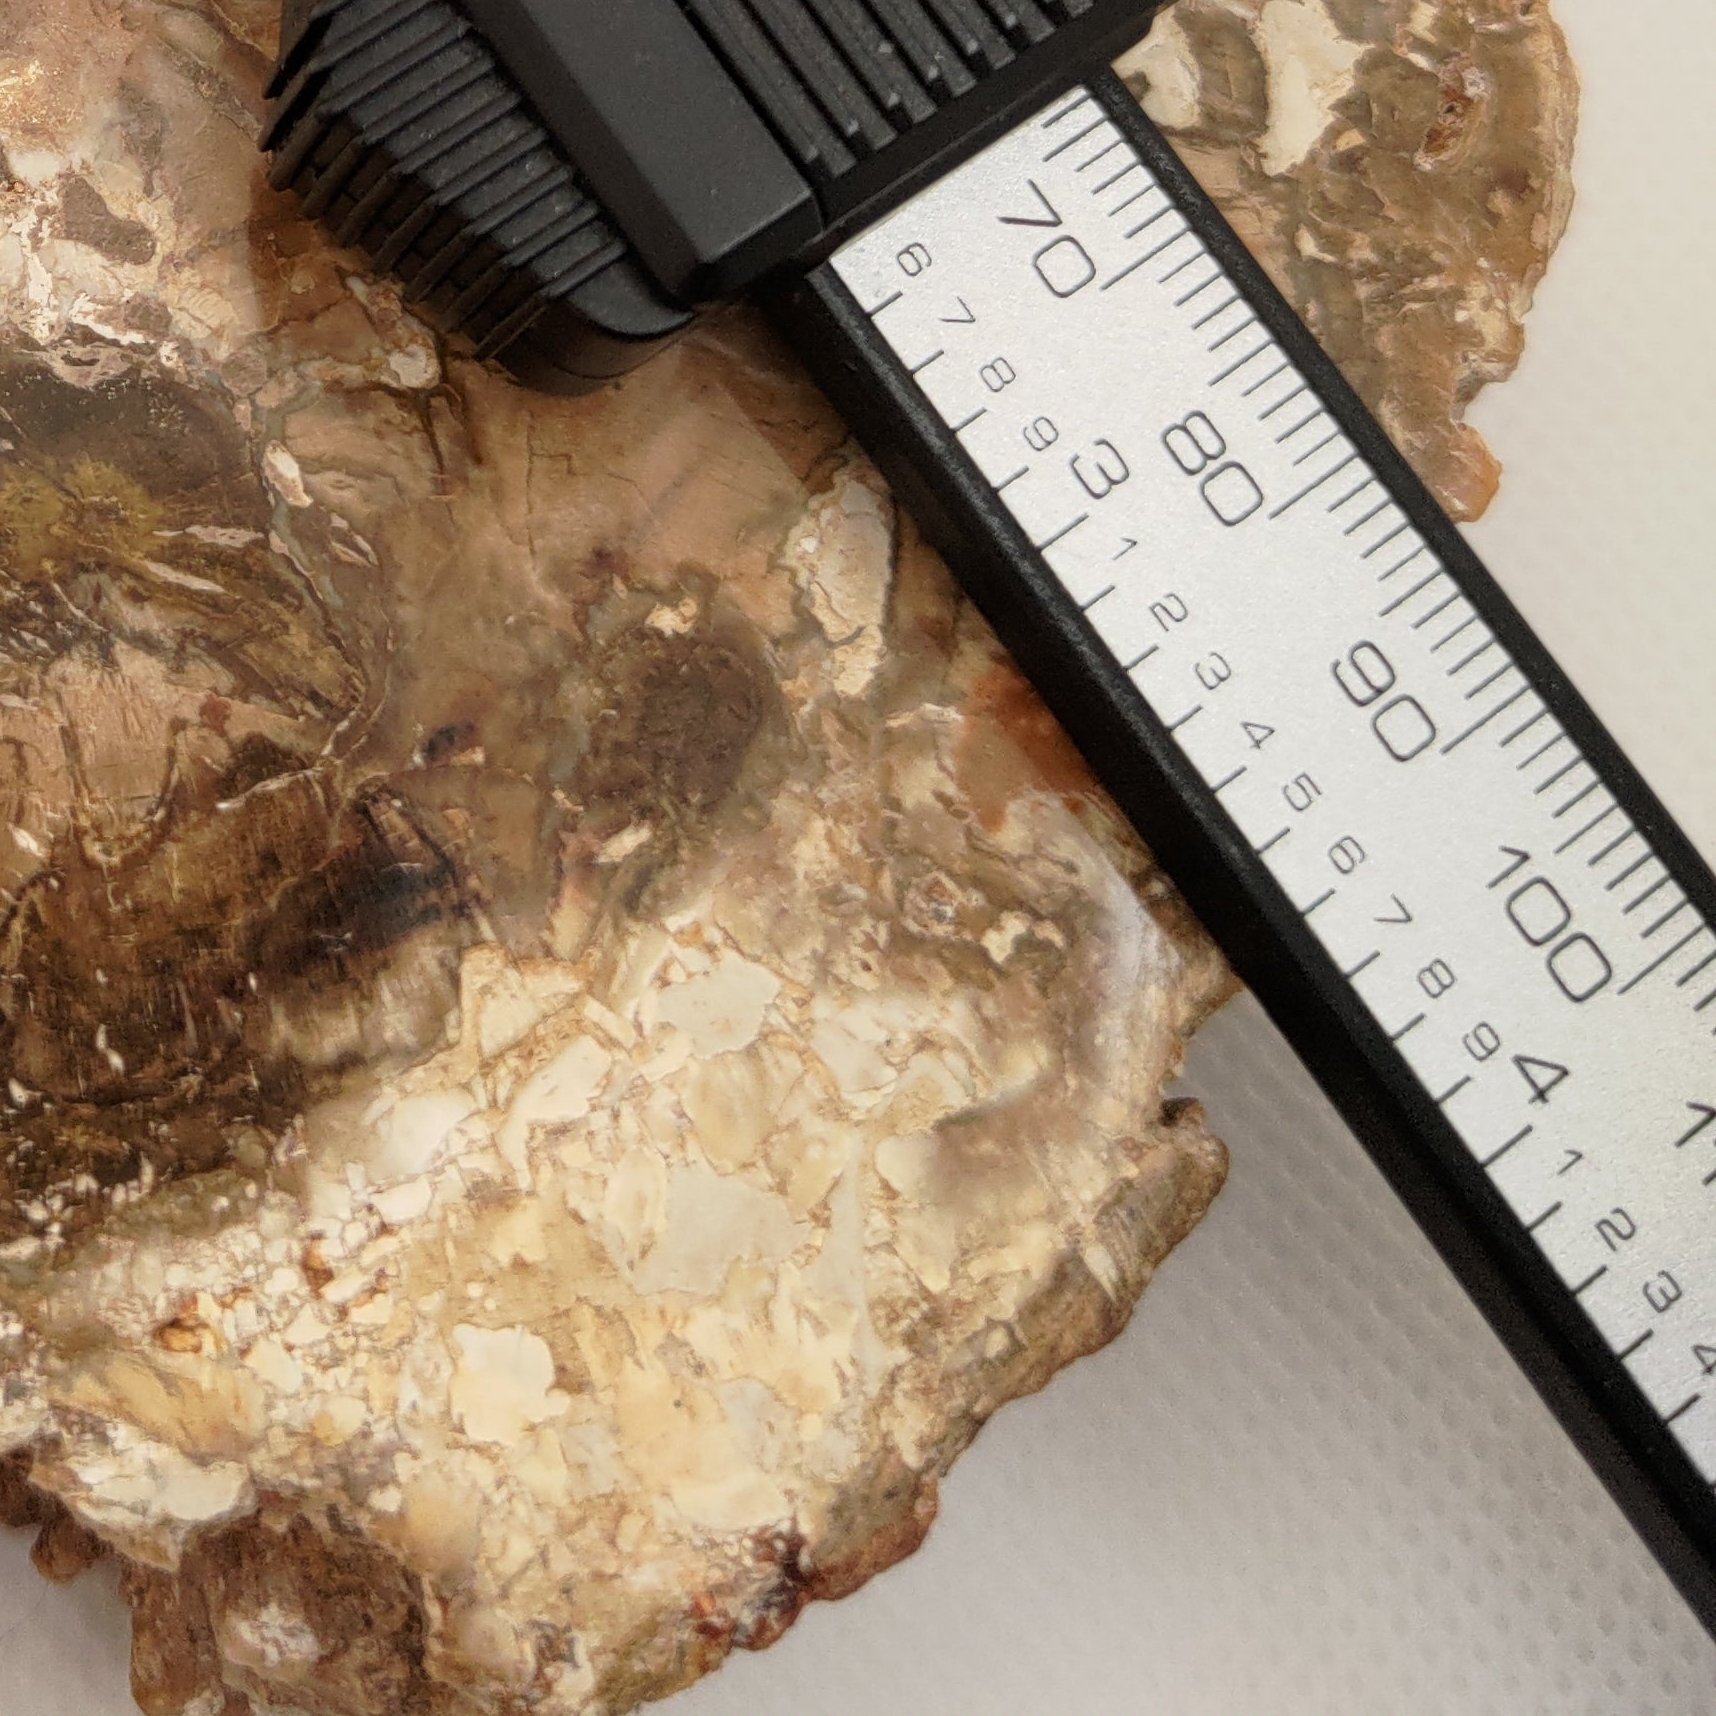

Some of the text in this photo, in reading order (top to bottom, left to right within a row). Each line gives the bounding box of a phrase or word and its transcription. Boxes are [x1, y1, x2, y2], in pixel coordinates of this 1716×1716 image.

[896, 242, 932, 277] 6
[939, 296, 976, 324] 7
[979, 357, 1016, 393] 8
[1023, 416, 1059, 452] 9
[1069, 438, 1130, 500] 3
[1113, 538, 1138, 560] 1
[1149, 593, 1188, 632] 2
[1195, 652, 1232, 690] 3
[1240, 720, 1276, 750] 4
[1282, 772, 1323, 812] 5
[1328, 835, 1366, 875] 6
[1374, 894, 1413, 924] 7
[1417, 958, 1457, 999] 8
[1462, 1021, 1501, 1063] 9
[1511, 1054, 1571, 1104] 4
[1557, 1149, 1584, 1175] 1
[1594, 1207, 1637, 1252] 2
[1643, 1270, 1684, 1314] 3
[997, 178, 1097, 298] 70
[1161, 410, 1264, 527] 80
[1329, 639, 1437, 762] 90
[1487, 845, 1612, 1002] 100
